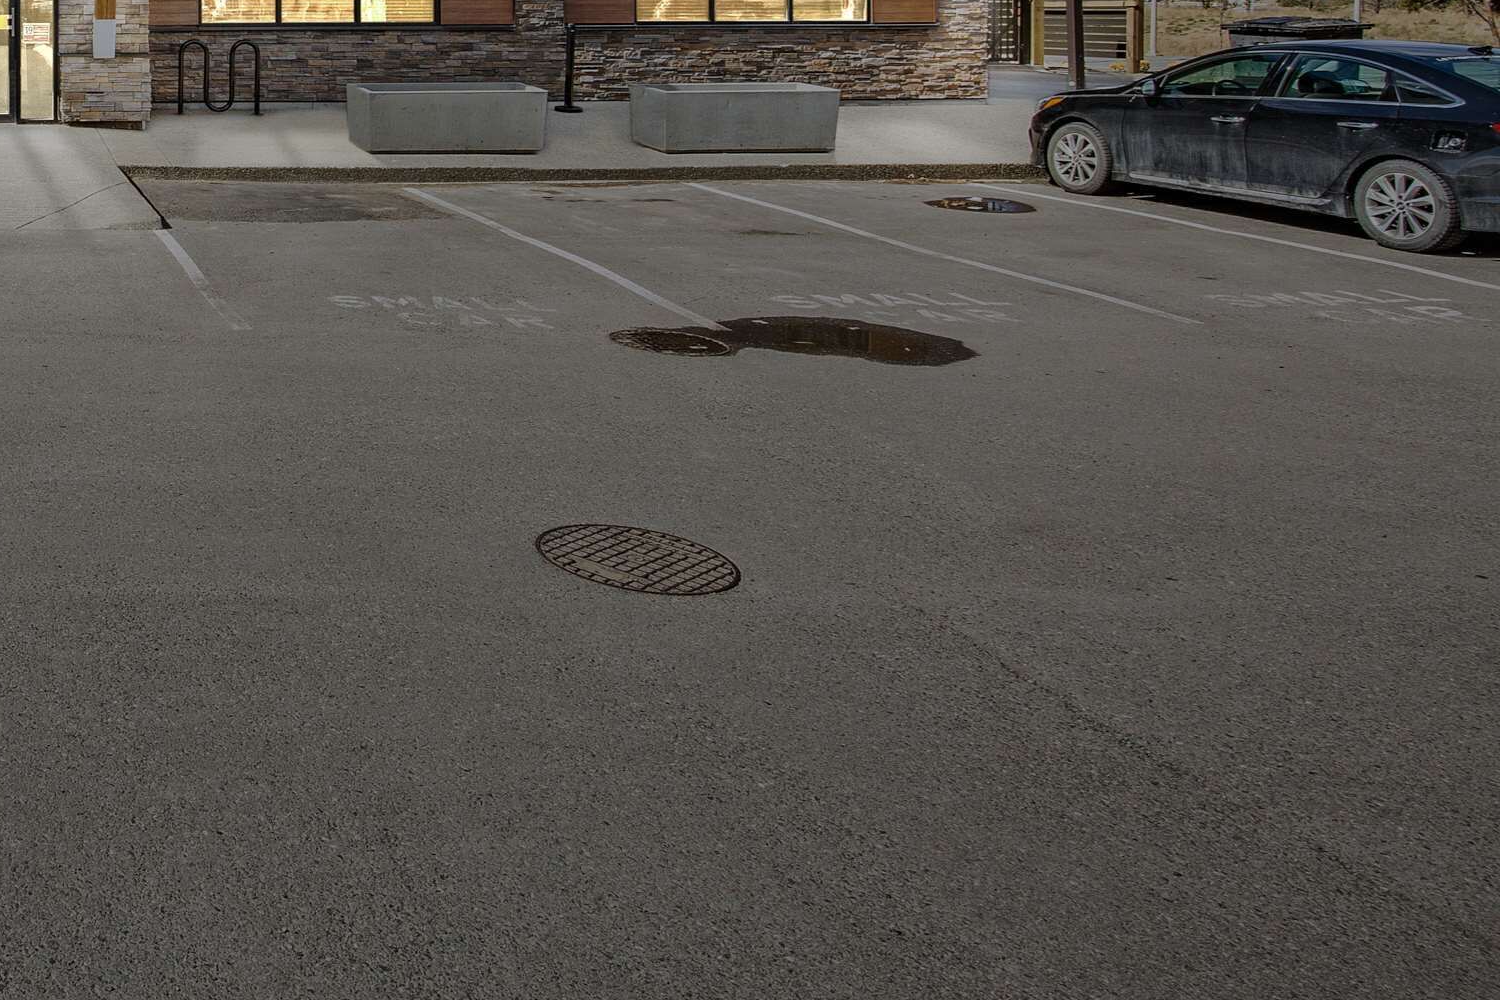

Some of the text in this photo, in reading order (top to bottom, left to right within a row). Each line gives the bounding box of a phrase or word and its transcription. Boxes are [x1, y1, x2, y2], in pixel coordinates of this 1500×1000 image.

[328, 295, 558, 312] SMALL
[770, 293, 1014, 309] SMALL
[1204, 289, 1452, 308] SMALL
